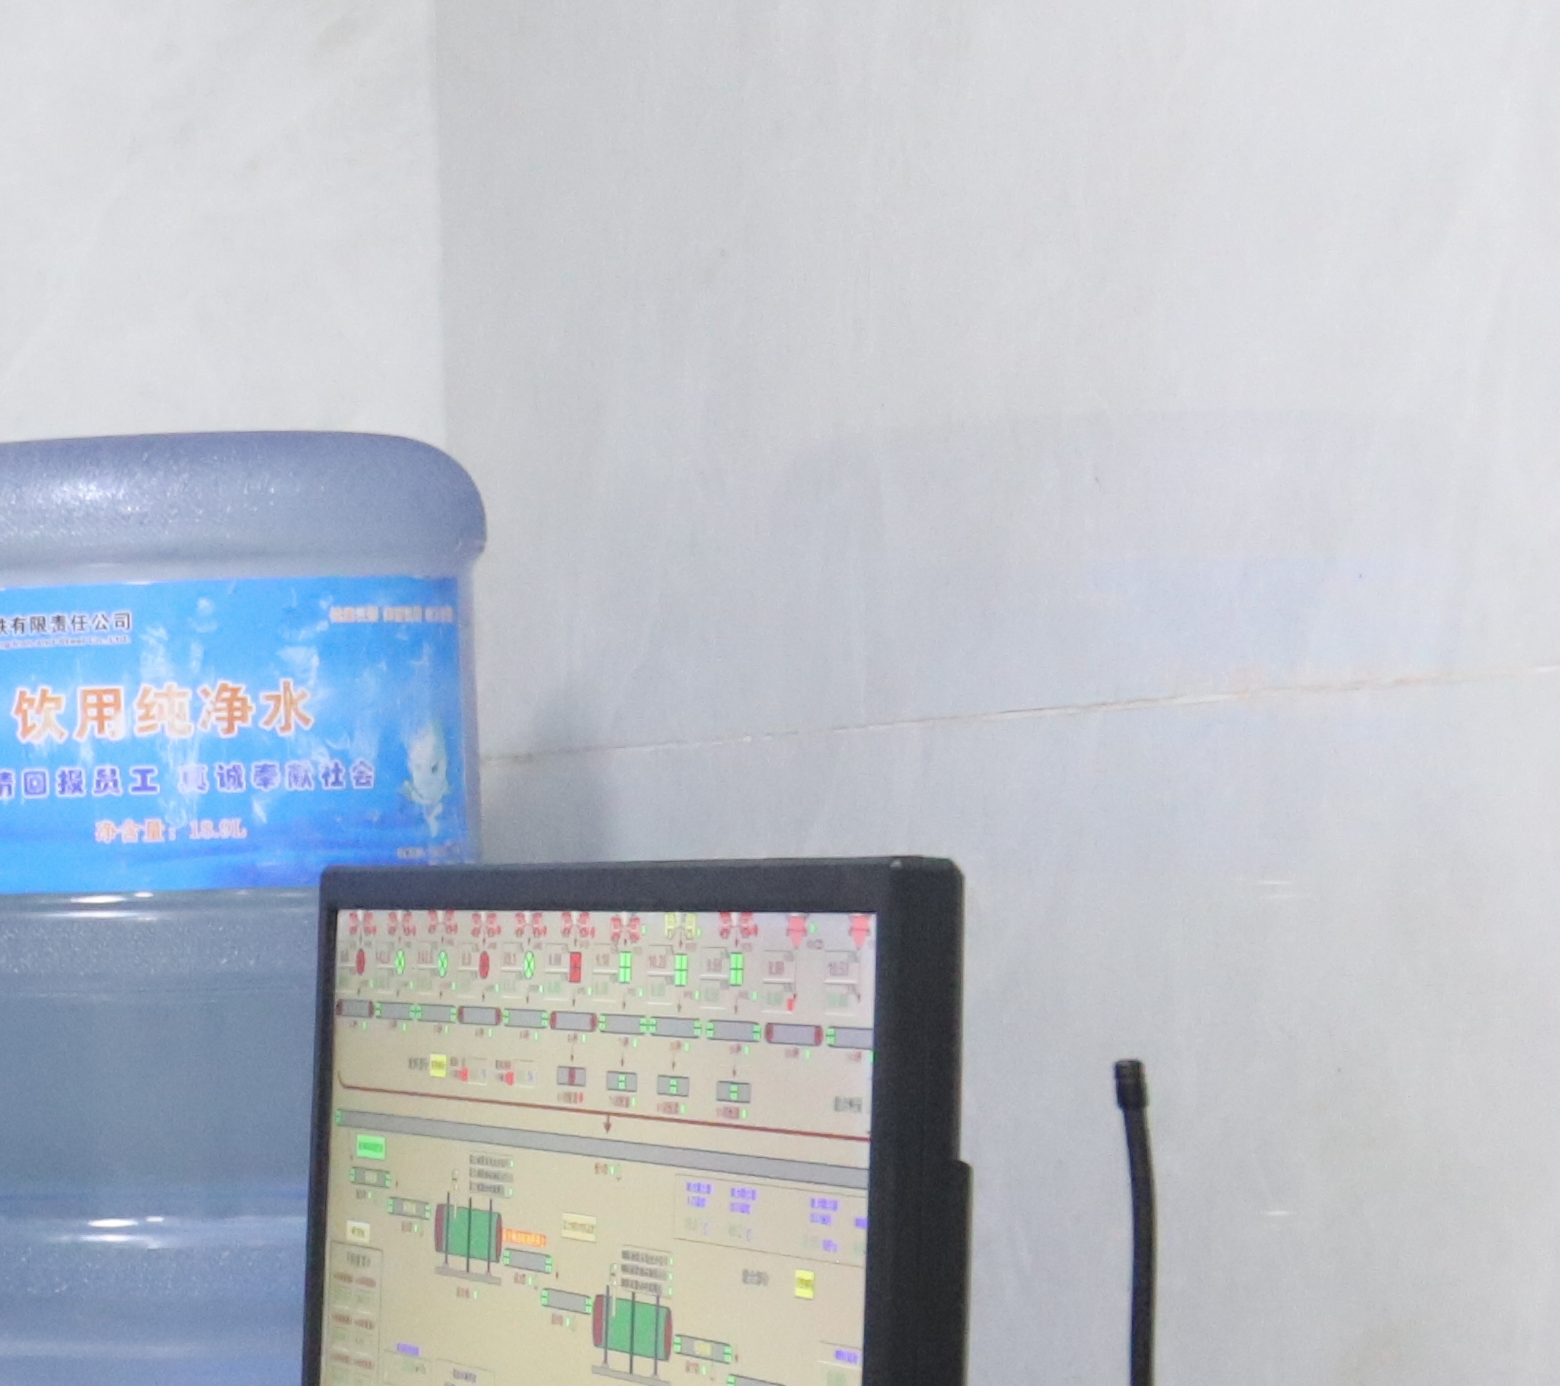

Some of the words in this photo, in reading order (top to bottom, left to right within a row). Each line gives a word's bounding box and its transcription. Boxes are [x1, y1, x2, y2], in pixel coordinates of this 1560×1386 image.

[11, 679, 315, 744] 饮用纯净水
[179, 759, 376, 792] 真诚奉献社会
